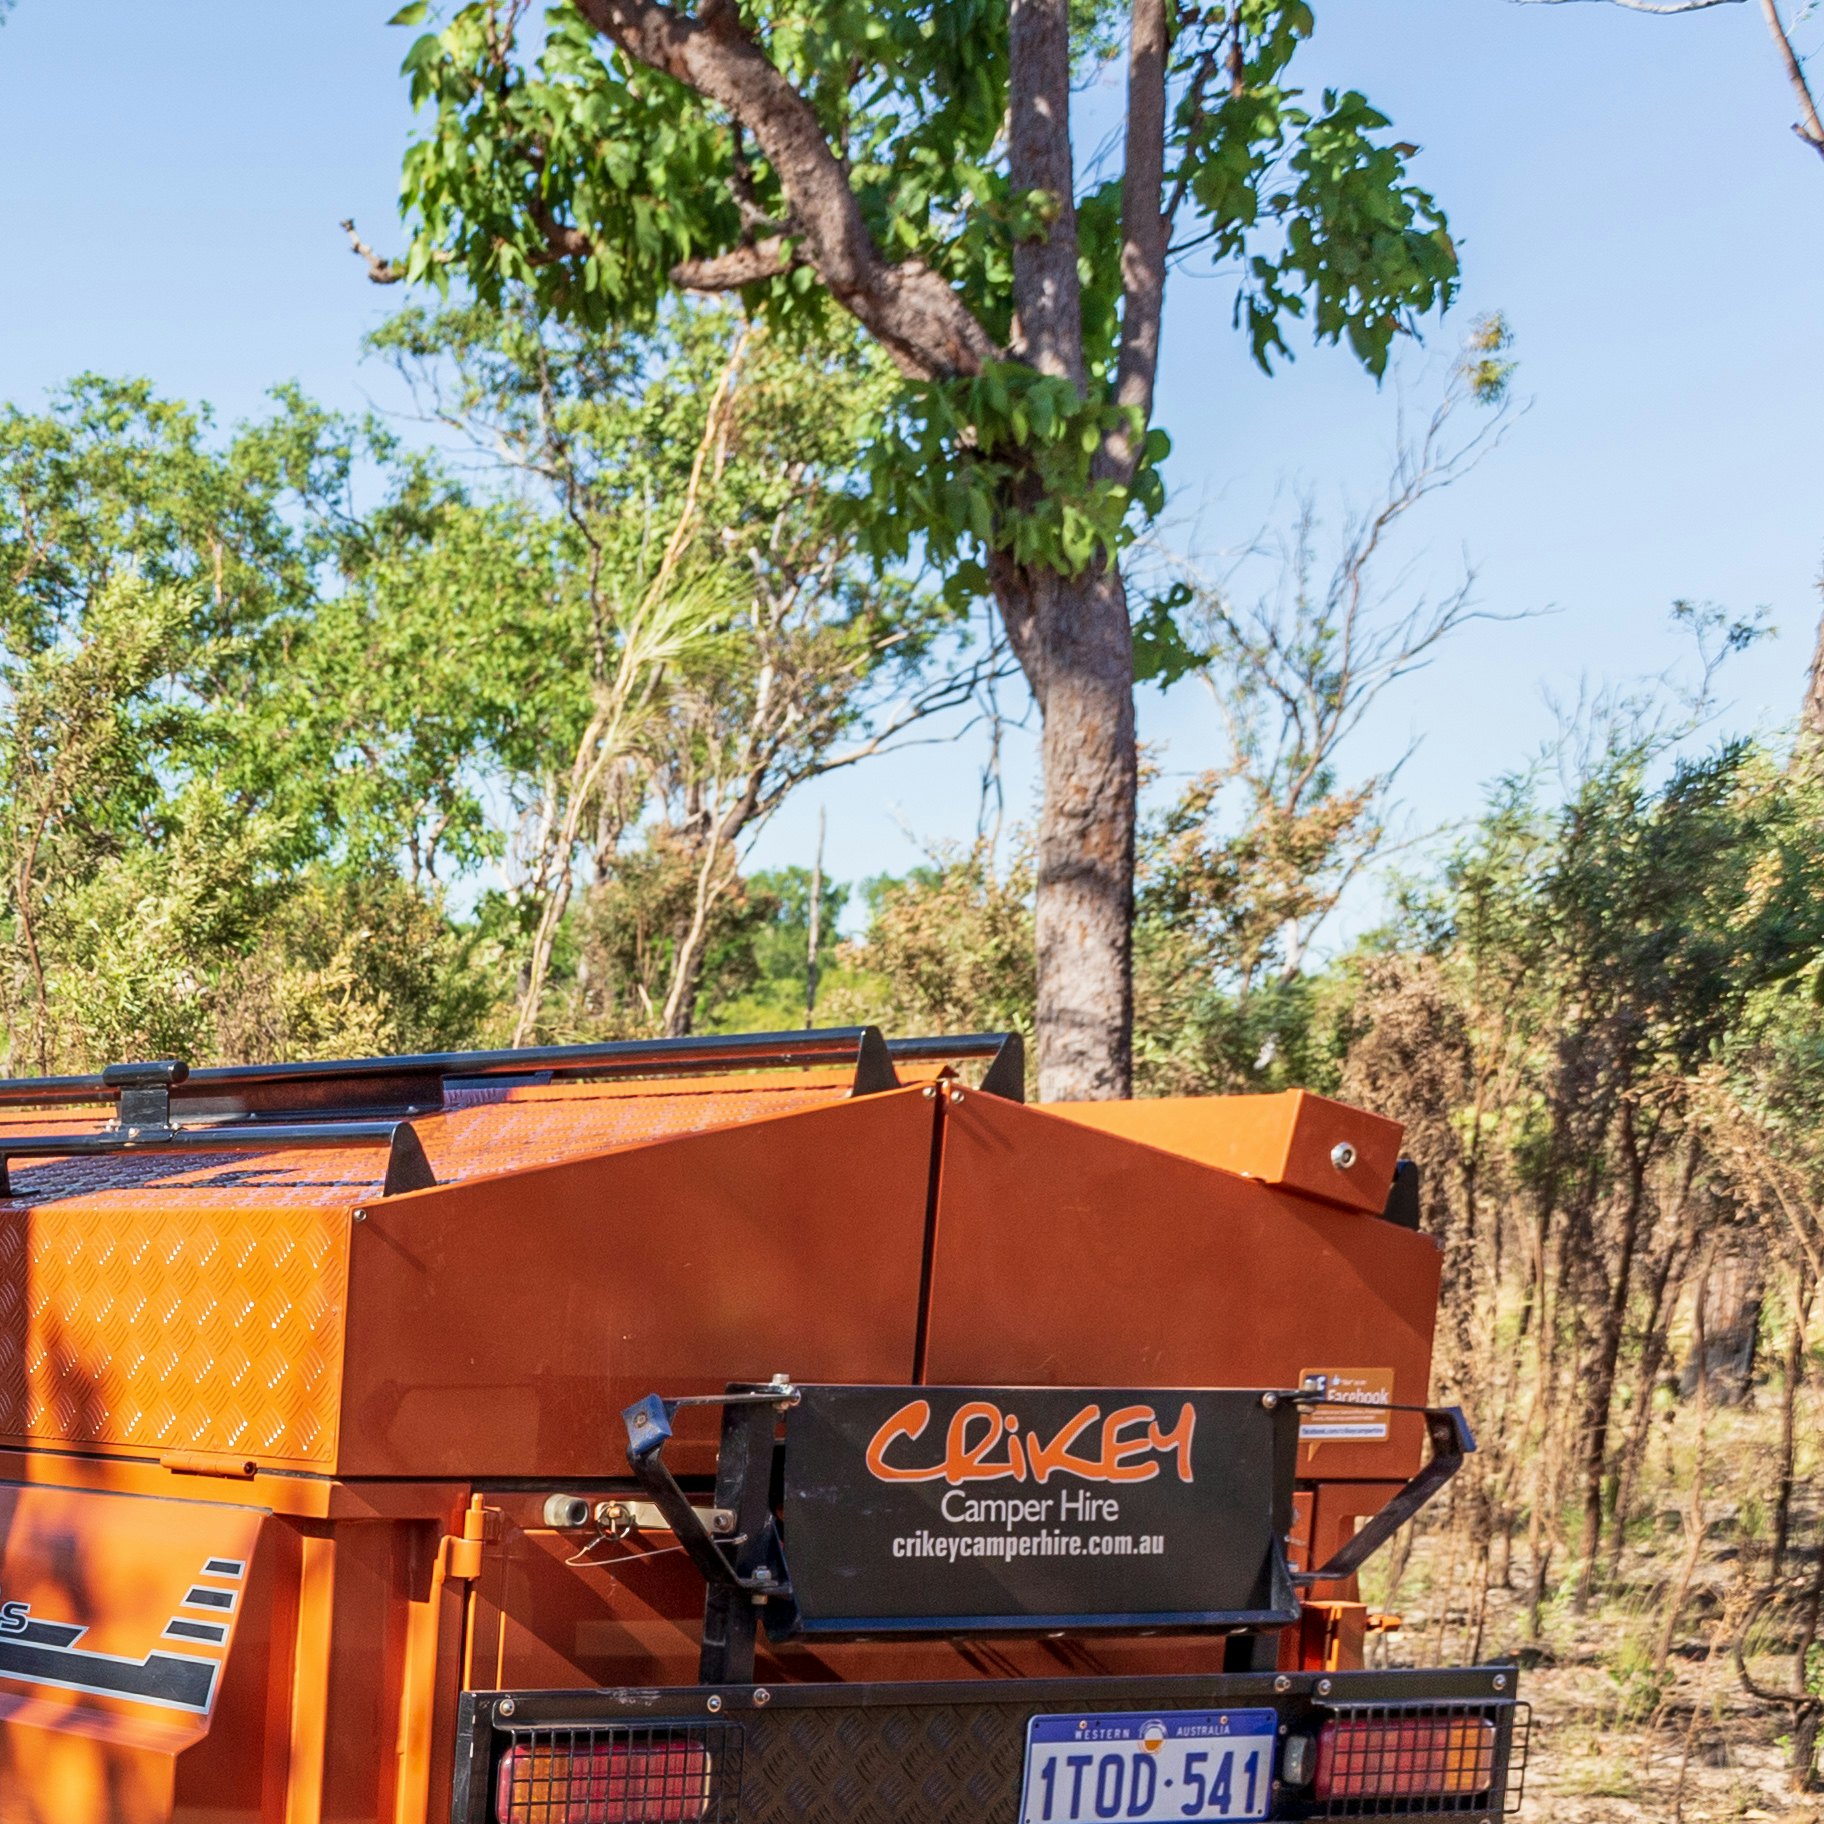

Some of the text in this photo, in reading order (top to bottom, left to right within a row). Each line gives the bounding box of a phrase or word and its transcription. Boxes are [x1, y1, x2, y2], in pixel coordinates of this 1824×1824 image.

[1327, 1387, 1389, 1405] Facebook
[941, 1489, 1119, 1531] Camper Hire
[892, 1529, 1164, 1563] crikeycamperhire.com.au
[1075, 1725, 1231, 1740] WESTERN AUSTRALIA
